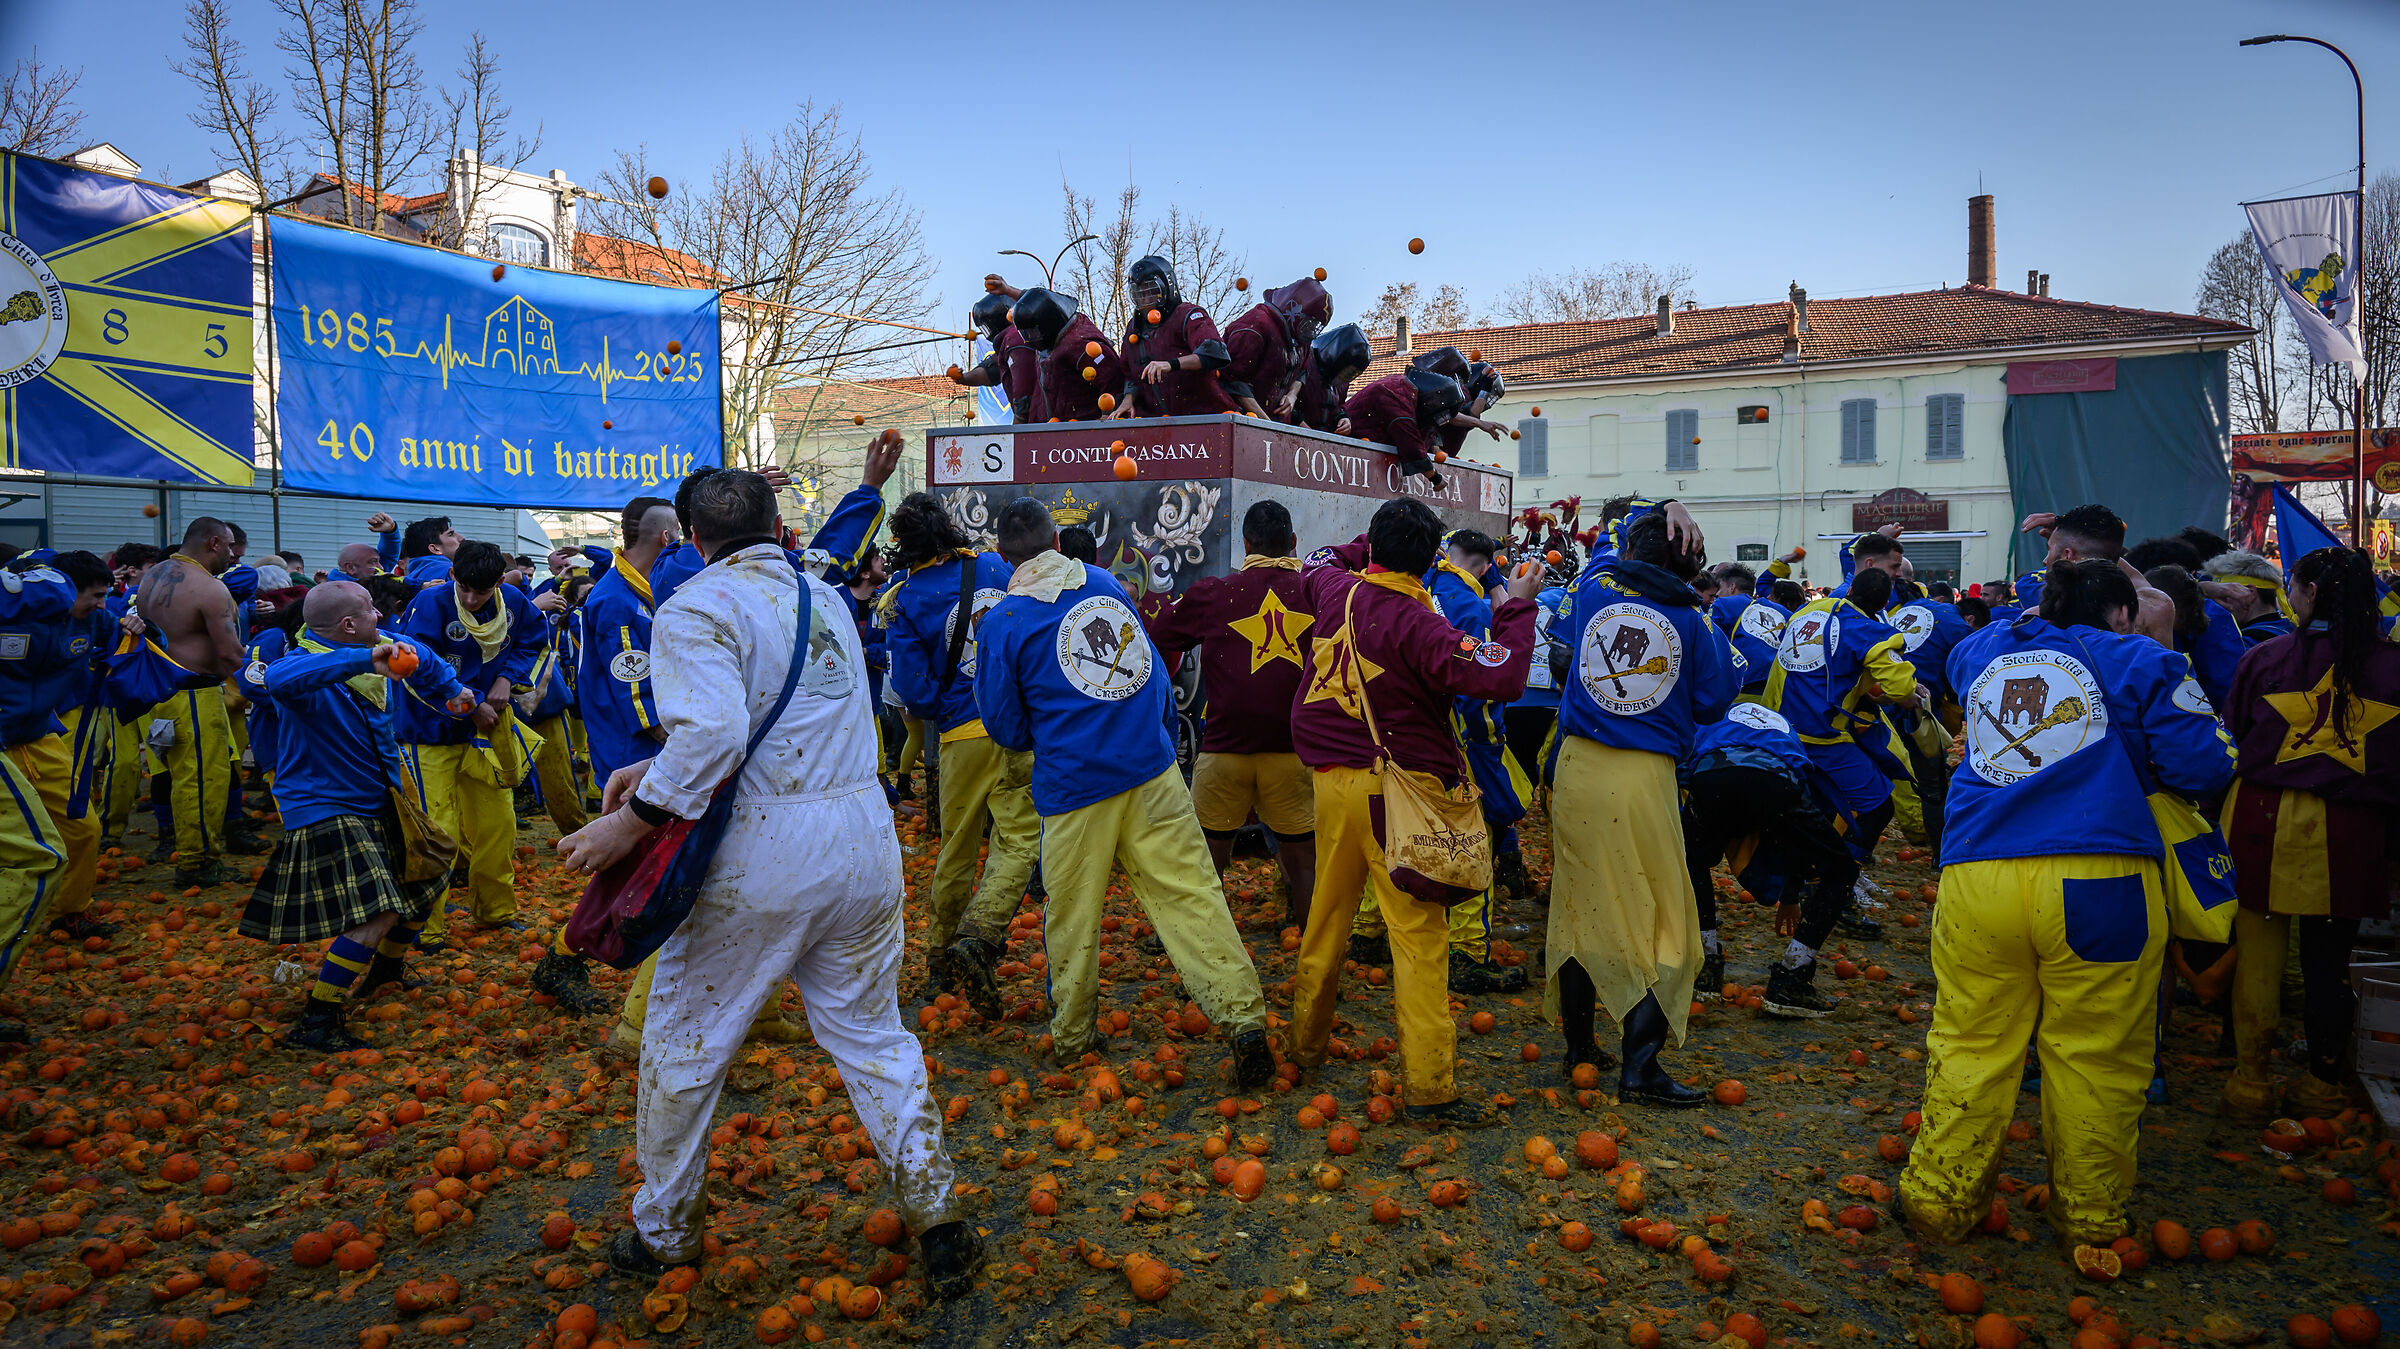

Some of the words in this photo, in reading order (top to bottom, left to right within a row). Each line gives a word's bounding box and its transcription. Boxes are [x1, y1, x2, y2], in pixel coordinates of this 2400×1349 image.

[103, 308, 129, 345] 8
[204, 323, 228, 358] 5
[299, 305, 396, 358] 1985
[634, 351, 703, 383] 2025
[317, 419, 374, 462] 40
[400, 434, 482, 474] anni
[502, 438, 534, 477] di
[554, 441, 694, 487] battaglie
[1031, 450, 1038, 465] I
[1048, 447, 1114, 464] CONTI
[1124, 443, 1210, 461] CASANA
[2278, 437, 2304, 449] ogne
[2311, 435, 2364, 447] speran
[983, 442, 1003, 473] S
[1262, 440, 1273, 473] I
[1294, 447, 1370, 488] CONTI
[1498, 483, 1507, 507] S
[1857, 503, 1943, 515] MACELLERIE
[1068, 601, 1094, 622] Storico
[1621, 604, 1656, 621] Storico
[2001, 653, 2048, 667] Storico
